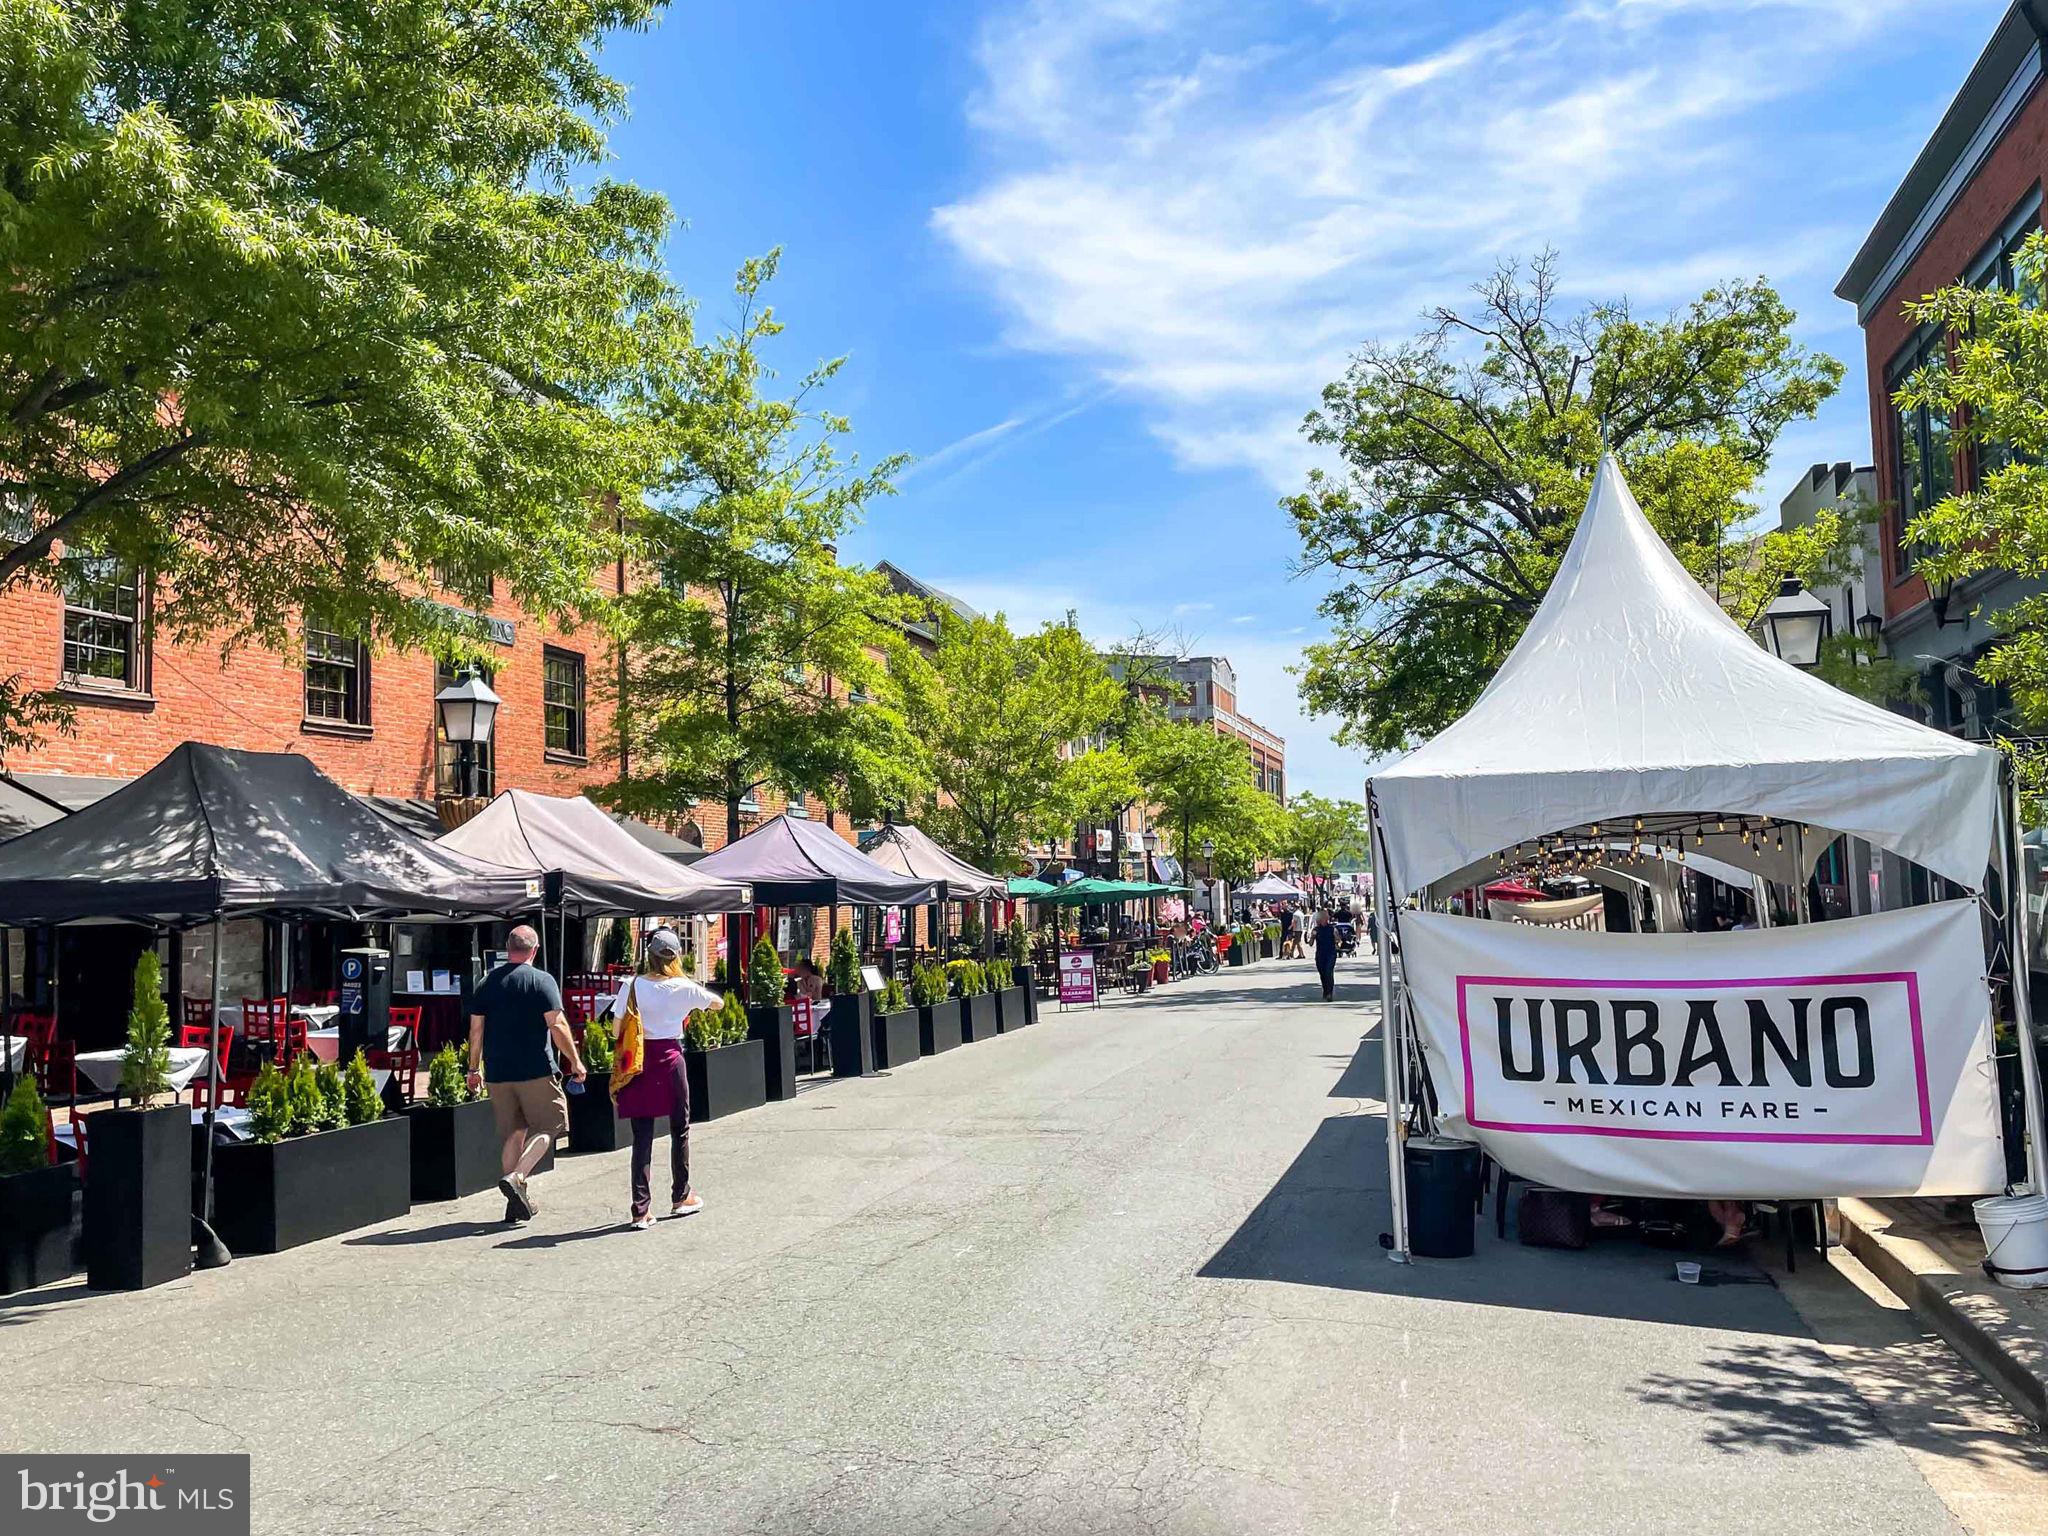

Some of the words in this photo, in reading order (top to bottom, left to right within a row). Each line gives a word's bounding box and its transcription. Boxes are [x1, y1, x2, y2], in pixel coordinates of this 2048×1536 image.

[1493, 996, 1876, 1089] URBANO
[1567, 1097, 1702, 1118] MEXICAN
[1720, 1101, 1800, 1119] FARE
